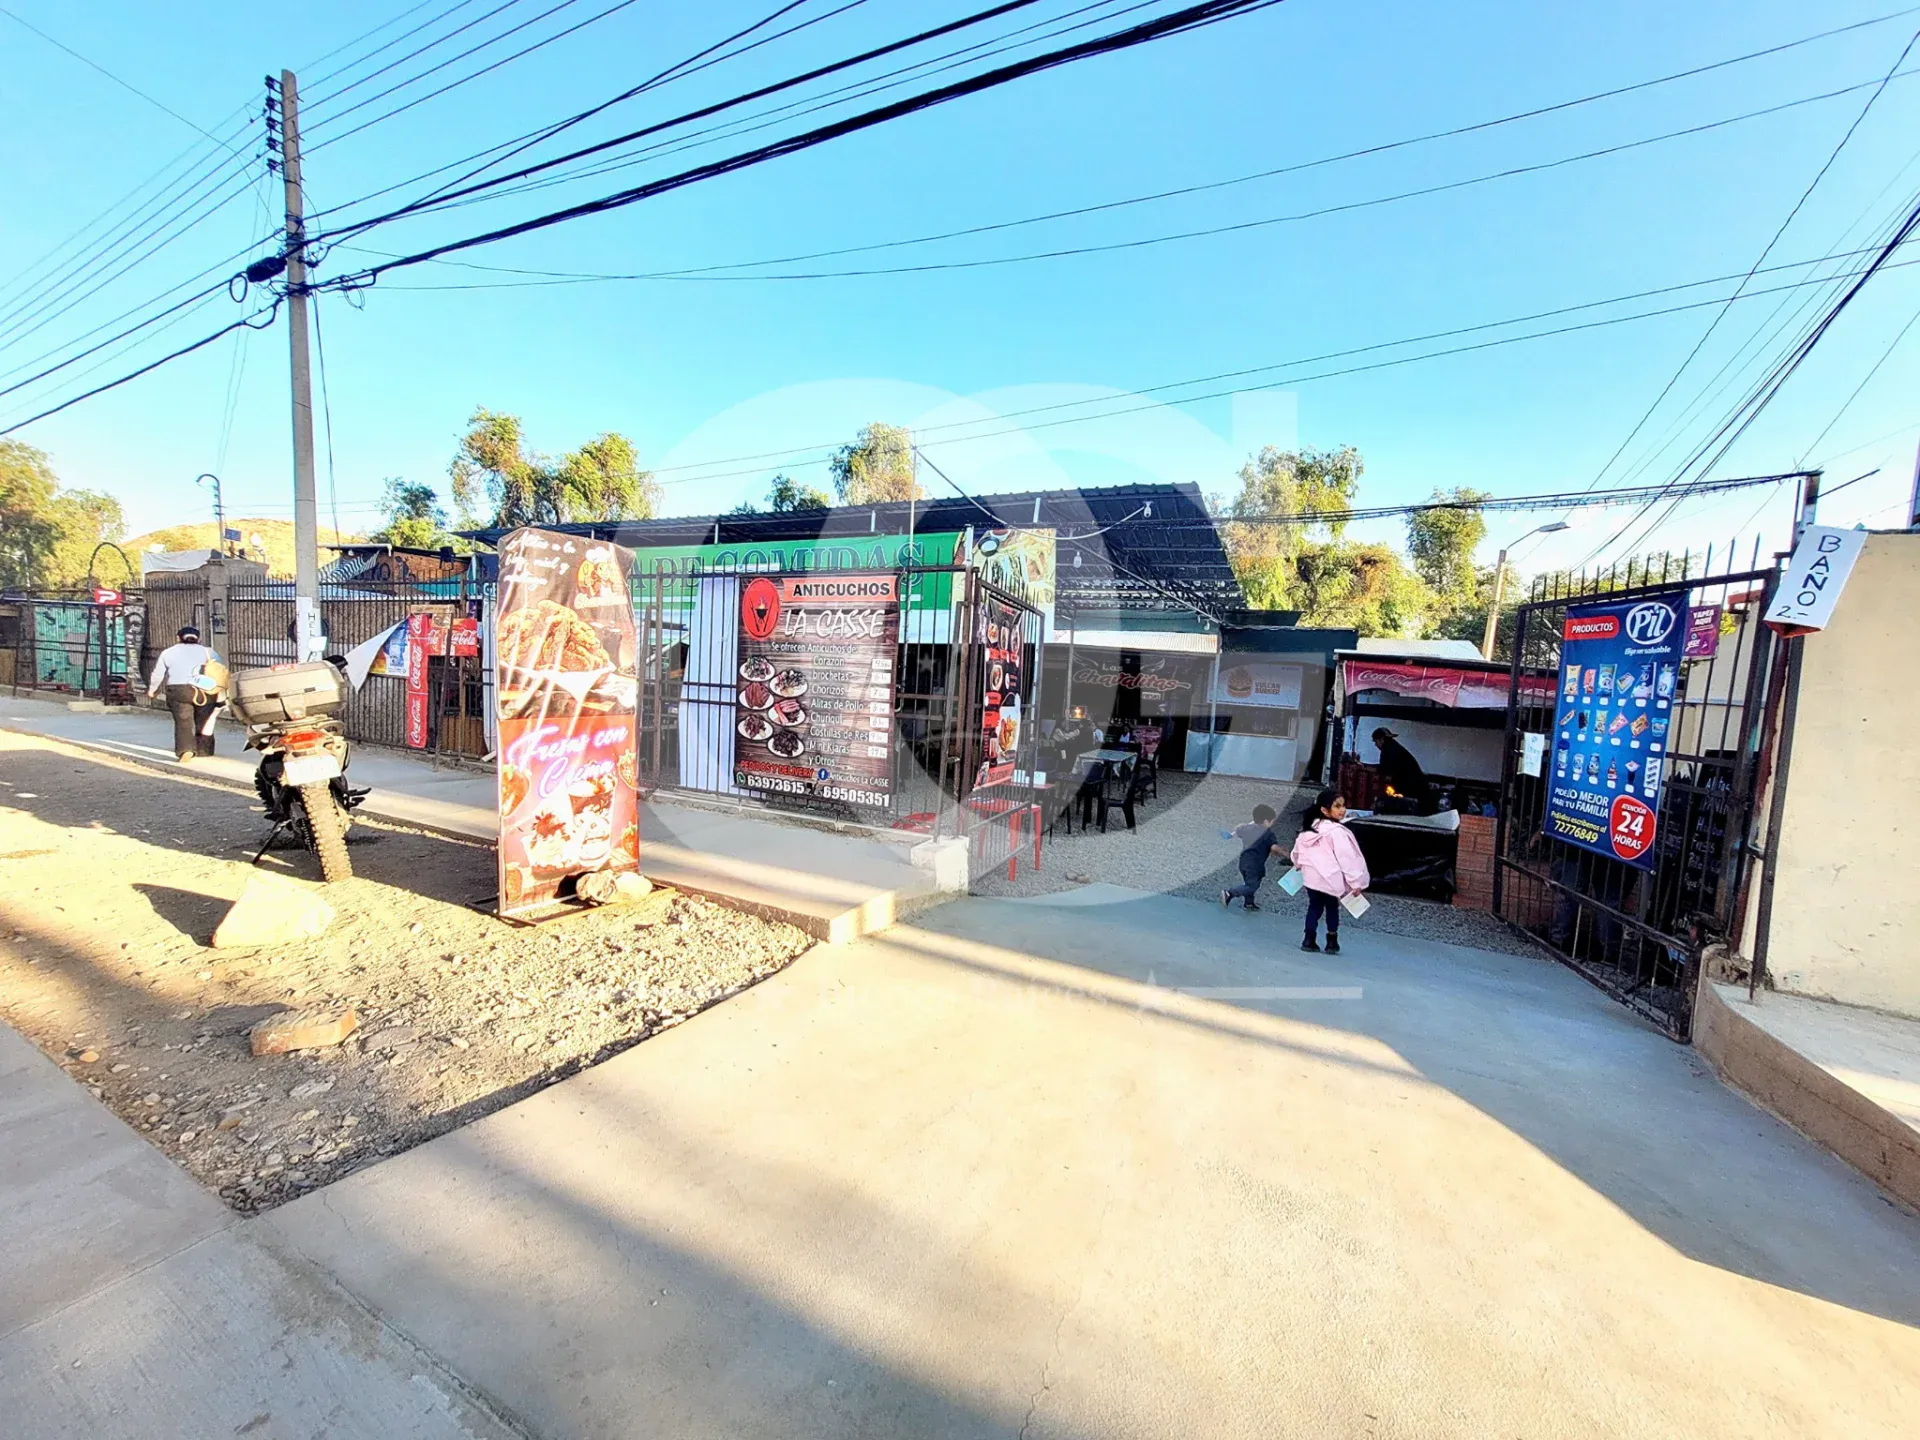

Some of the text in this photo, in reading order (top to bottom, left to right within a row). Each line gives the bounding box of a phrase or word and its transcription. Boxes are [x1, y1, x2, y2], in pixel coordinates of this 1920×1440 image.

[714, 542, 924, 588] COMIDAS
[793, 583, 890, 597] ANTICUCHOS
[784, 608, 885, 639] LA CASSE
[1571, 622, 1614, 635] PRODUCTOS
[811, 683, 845, 696] Chorizos
[1073, 668, 1191, 691] Chavalitas
[747, 775, 890, 807] 63973615 69505351
[1579, 791, 1610, 807] MEJOR
[1575, 800, 1609, 819] FAMILIA
[1553, 819, 1599, 844] 72776849
[1616, 810, 1645, 837] 24
[1613, 833, 1643, 850] HORAS
